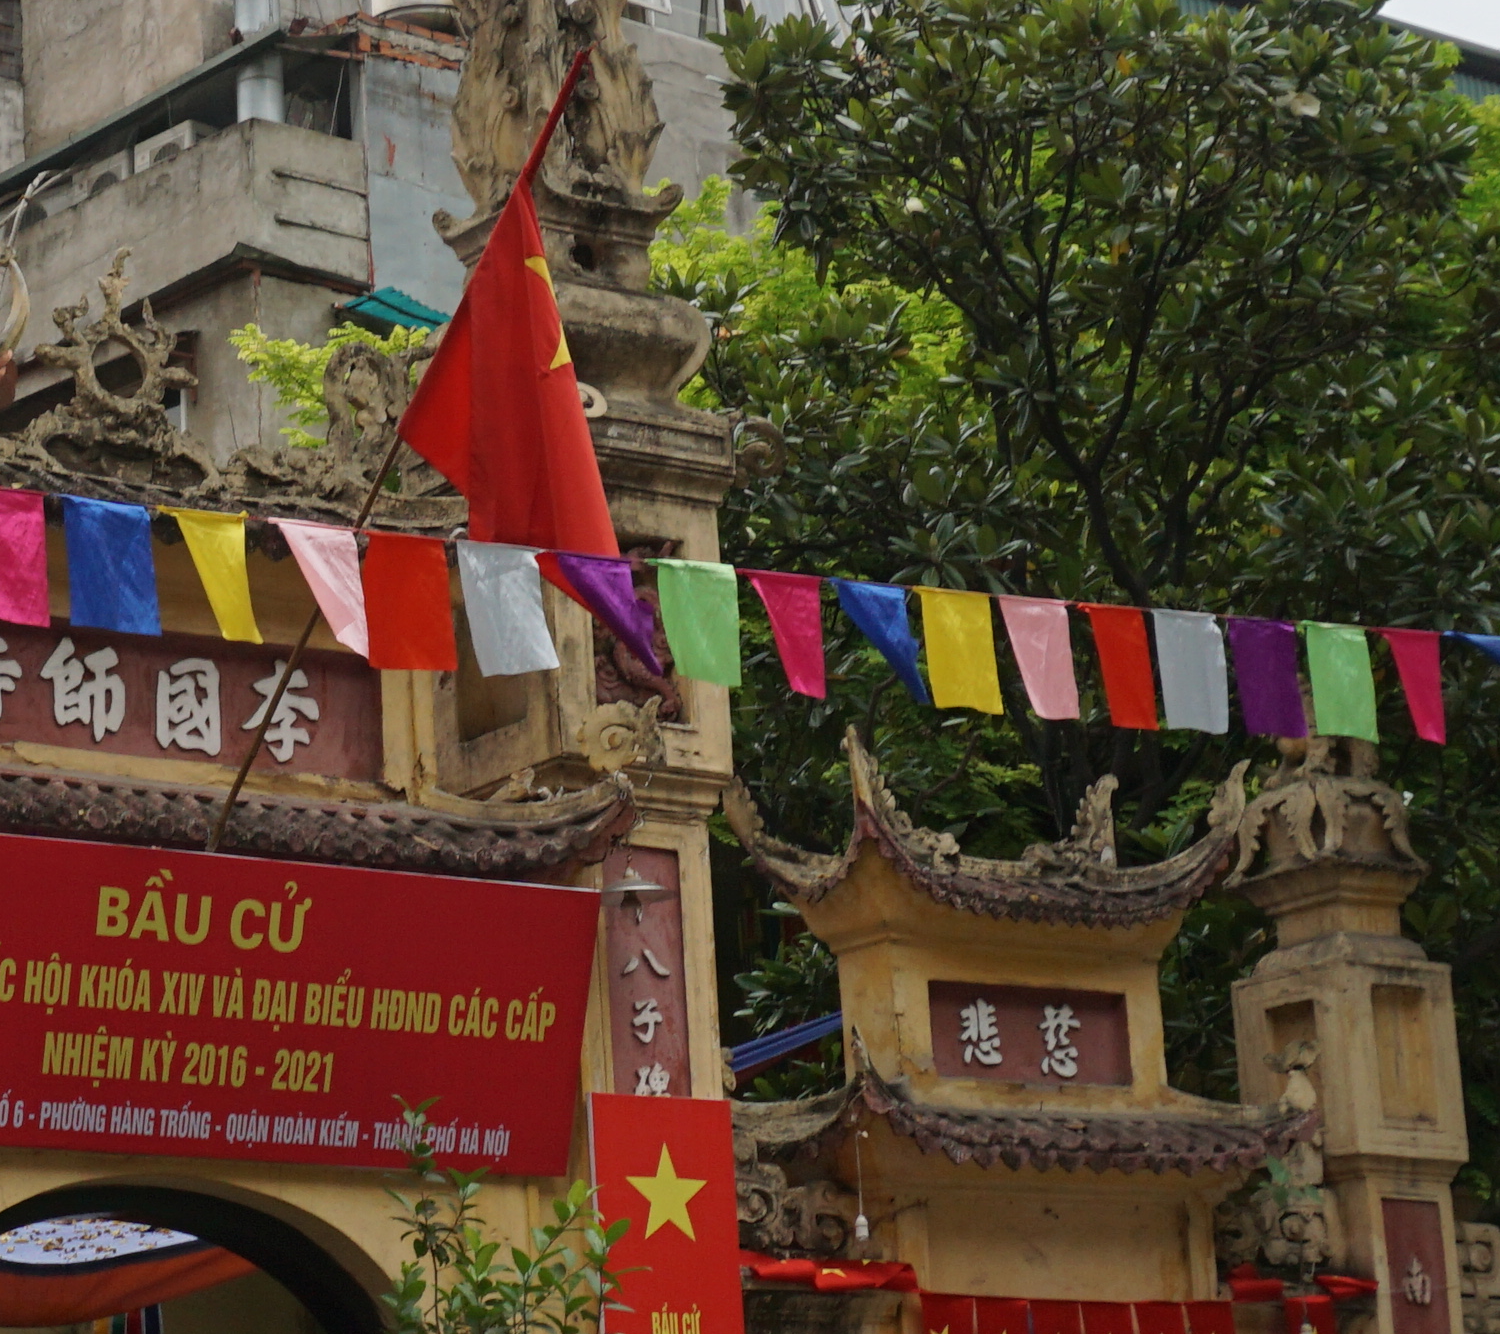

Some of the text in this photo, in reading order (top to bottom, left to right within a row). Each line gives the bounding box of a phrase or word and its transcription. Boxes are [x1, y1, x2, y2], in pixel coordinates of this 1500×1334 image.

[95, 868, 313, 953] BẦU CỬ
[23, 952, 72, 1015] HỘI
[78, 958, 151, 1012] KHÓA
[158, 971, 206, 1016] XIV
[212, 967, 244, 1019] VÀ
[252, 978, 298, 1032] ĐẠI
[303, 968, 365, 1028] BIỂU
[370, 988, 442, 1034] HĐND
[448, 987, 499, 1039] CÁC
[505, 988, 556, 1042] CẤP
[42, 1025, 133, 1088] NHIỆM
[140, 1031, 177, 1083] KỲ
[182, 1042, 248, 1088] 2016
[271, 1048, 334, 1093] 2021
[13, 1101, 24, 1128] 6
[39, 1100, 107, 1133] PHƯỜNG
[110, 1101, 155, 1136] HÀNG
[160, 1105, 212, 1139] TRỐNG
[225, 1109, 270, 1148] QUẬN
[272, 1116, 317, 1145] HOÀN
[320, 1114, 359, 1147] KIẾM
[459, 1128, 479, 1154] HÀ
[483, 1125, 510, 1161] NỘI
